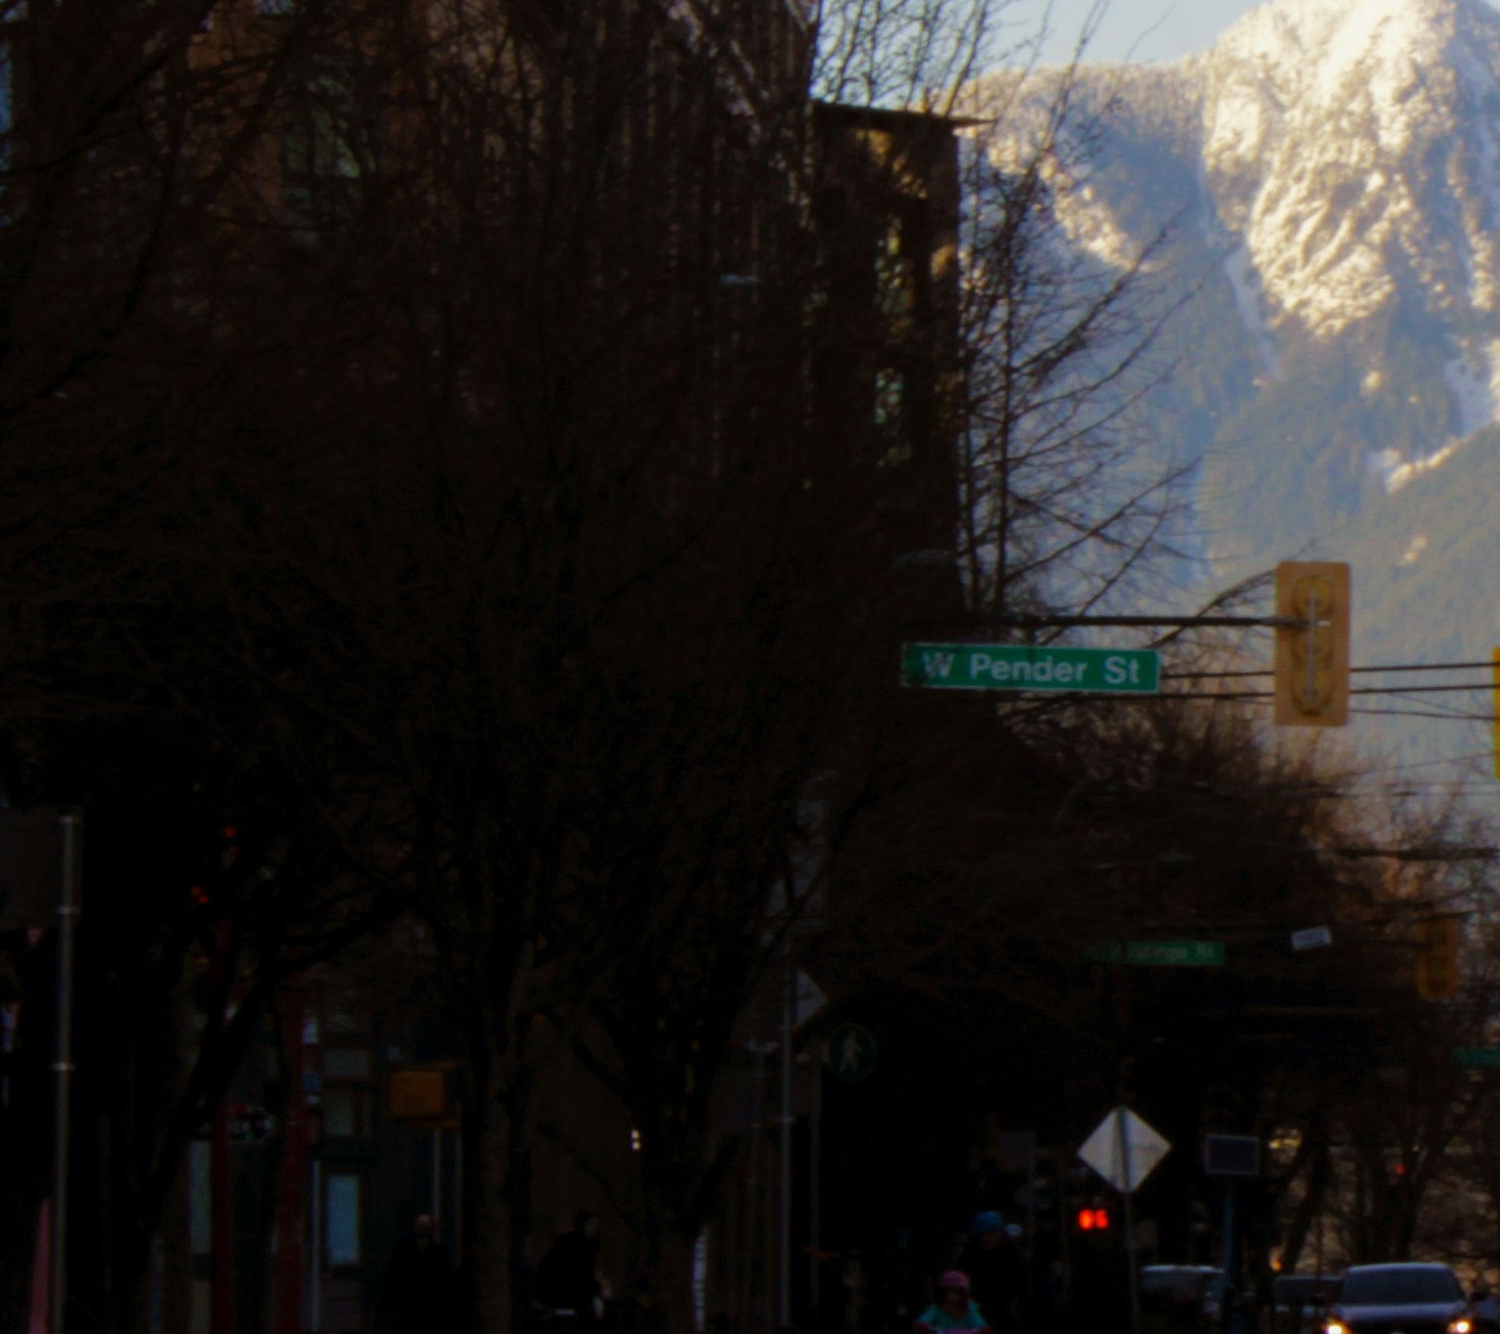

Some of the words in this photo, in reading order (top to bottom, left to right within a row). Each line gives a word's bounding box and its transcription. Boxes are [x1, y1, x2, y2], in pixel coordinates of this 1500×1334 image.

[922, 651, 956, 680] W
[969, 652, 1090, 683] Pender
[1103, 655, 1141, 685] St
